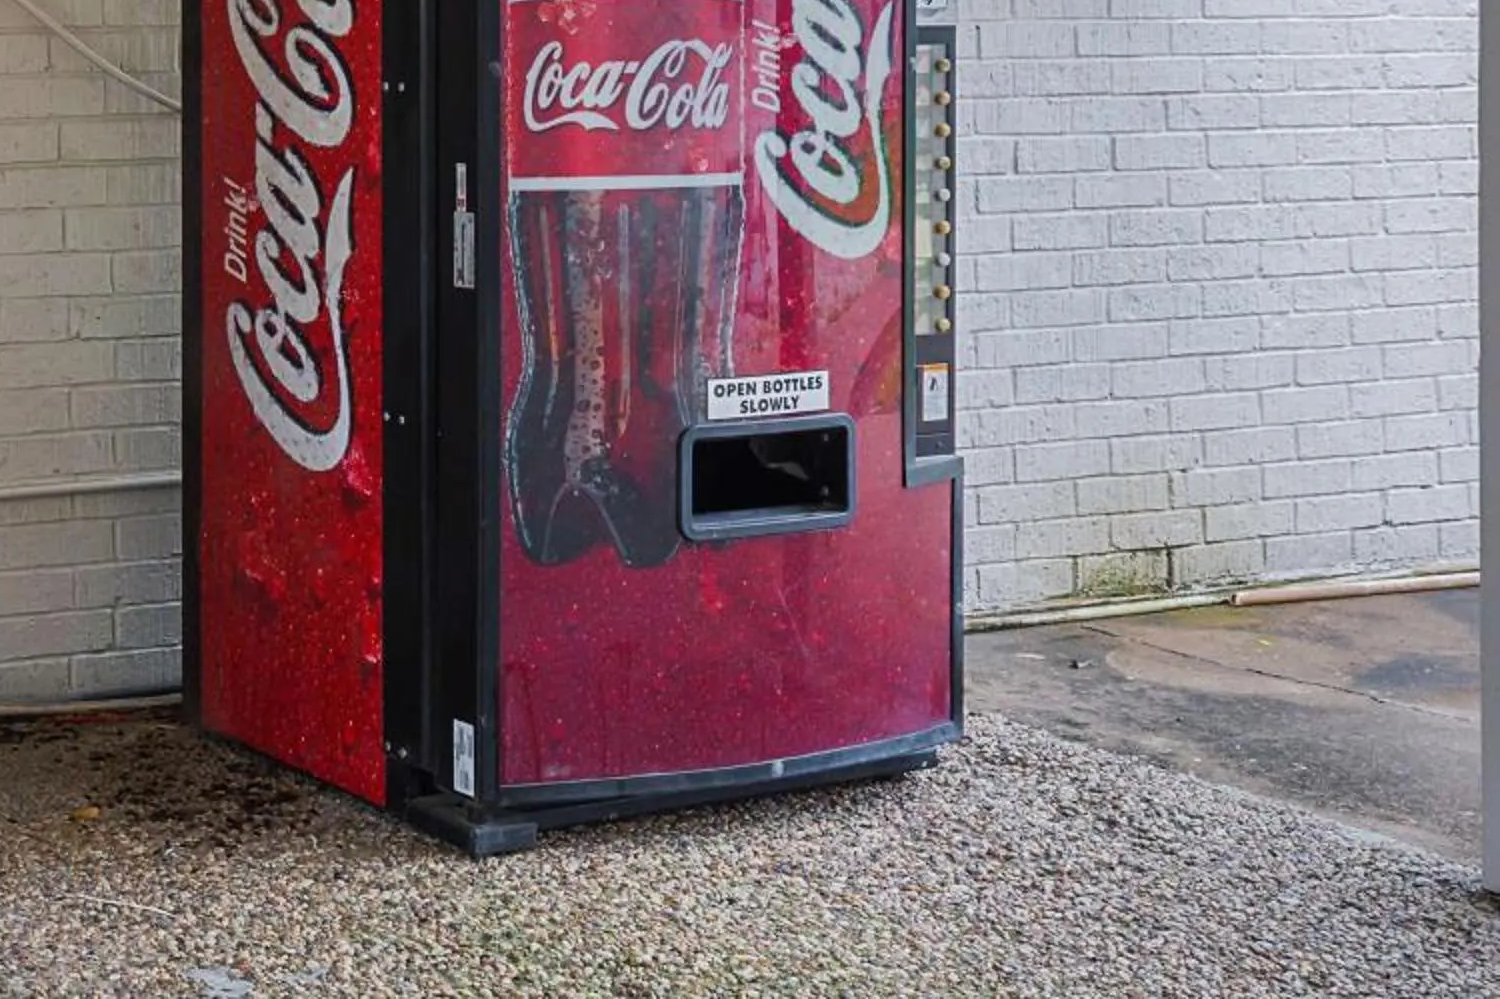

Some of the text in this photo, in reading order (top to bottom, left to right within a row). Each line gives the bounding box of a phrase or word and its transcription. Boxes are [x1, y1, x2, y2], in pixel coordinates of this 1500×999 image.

[523, 38, 733, 132] Coca-Cola
[751, 18, 781, 113] Drink!
[224, 177, 251, 283] Drink!
[713, 376, 823, 398] OPEN BOTTLES
[740, 396, 800, 414] SLOWLY
